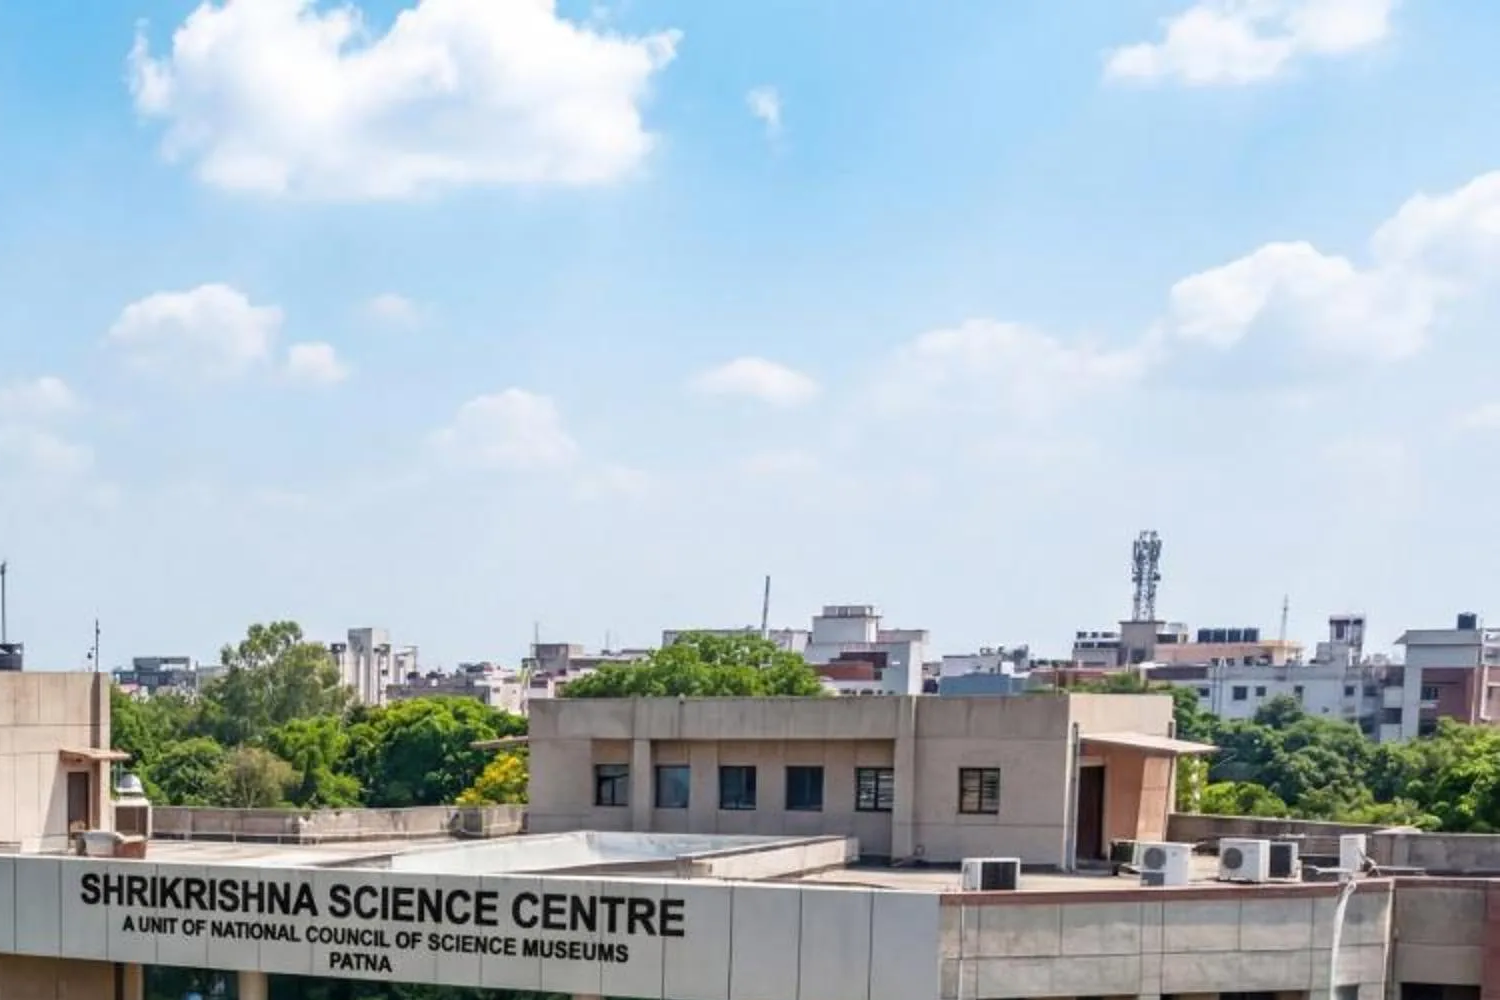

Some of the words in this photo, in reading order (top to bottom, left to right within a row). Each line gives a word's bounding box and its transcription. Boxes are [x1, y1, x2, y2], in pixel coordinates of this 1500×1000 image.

[80, 873, 318, 917] SHRIKRISHNA
[328, 884, 499, 926] SCIENCE
[512, 892, 684, 937] CENTRE
[122, 915, 135, 931] A
[138, 916, 178, 934] UNIT
[182, 919, 207, 936] OF
[211, 920, 301, 942] NATIONAL
[306, 925, 391, 948] COUNCIL
[395, 931, 422, 949] OF
[428, 933, 516, 956] SCIENCE
[522, 938, 628, 963] MUSEUMS
[330, 952, 392, 972] PATNA
